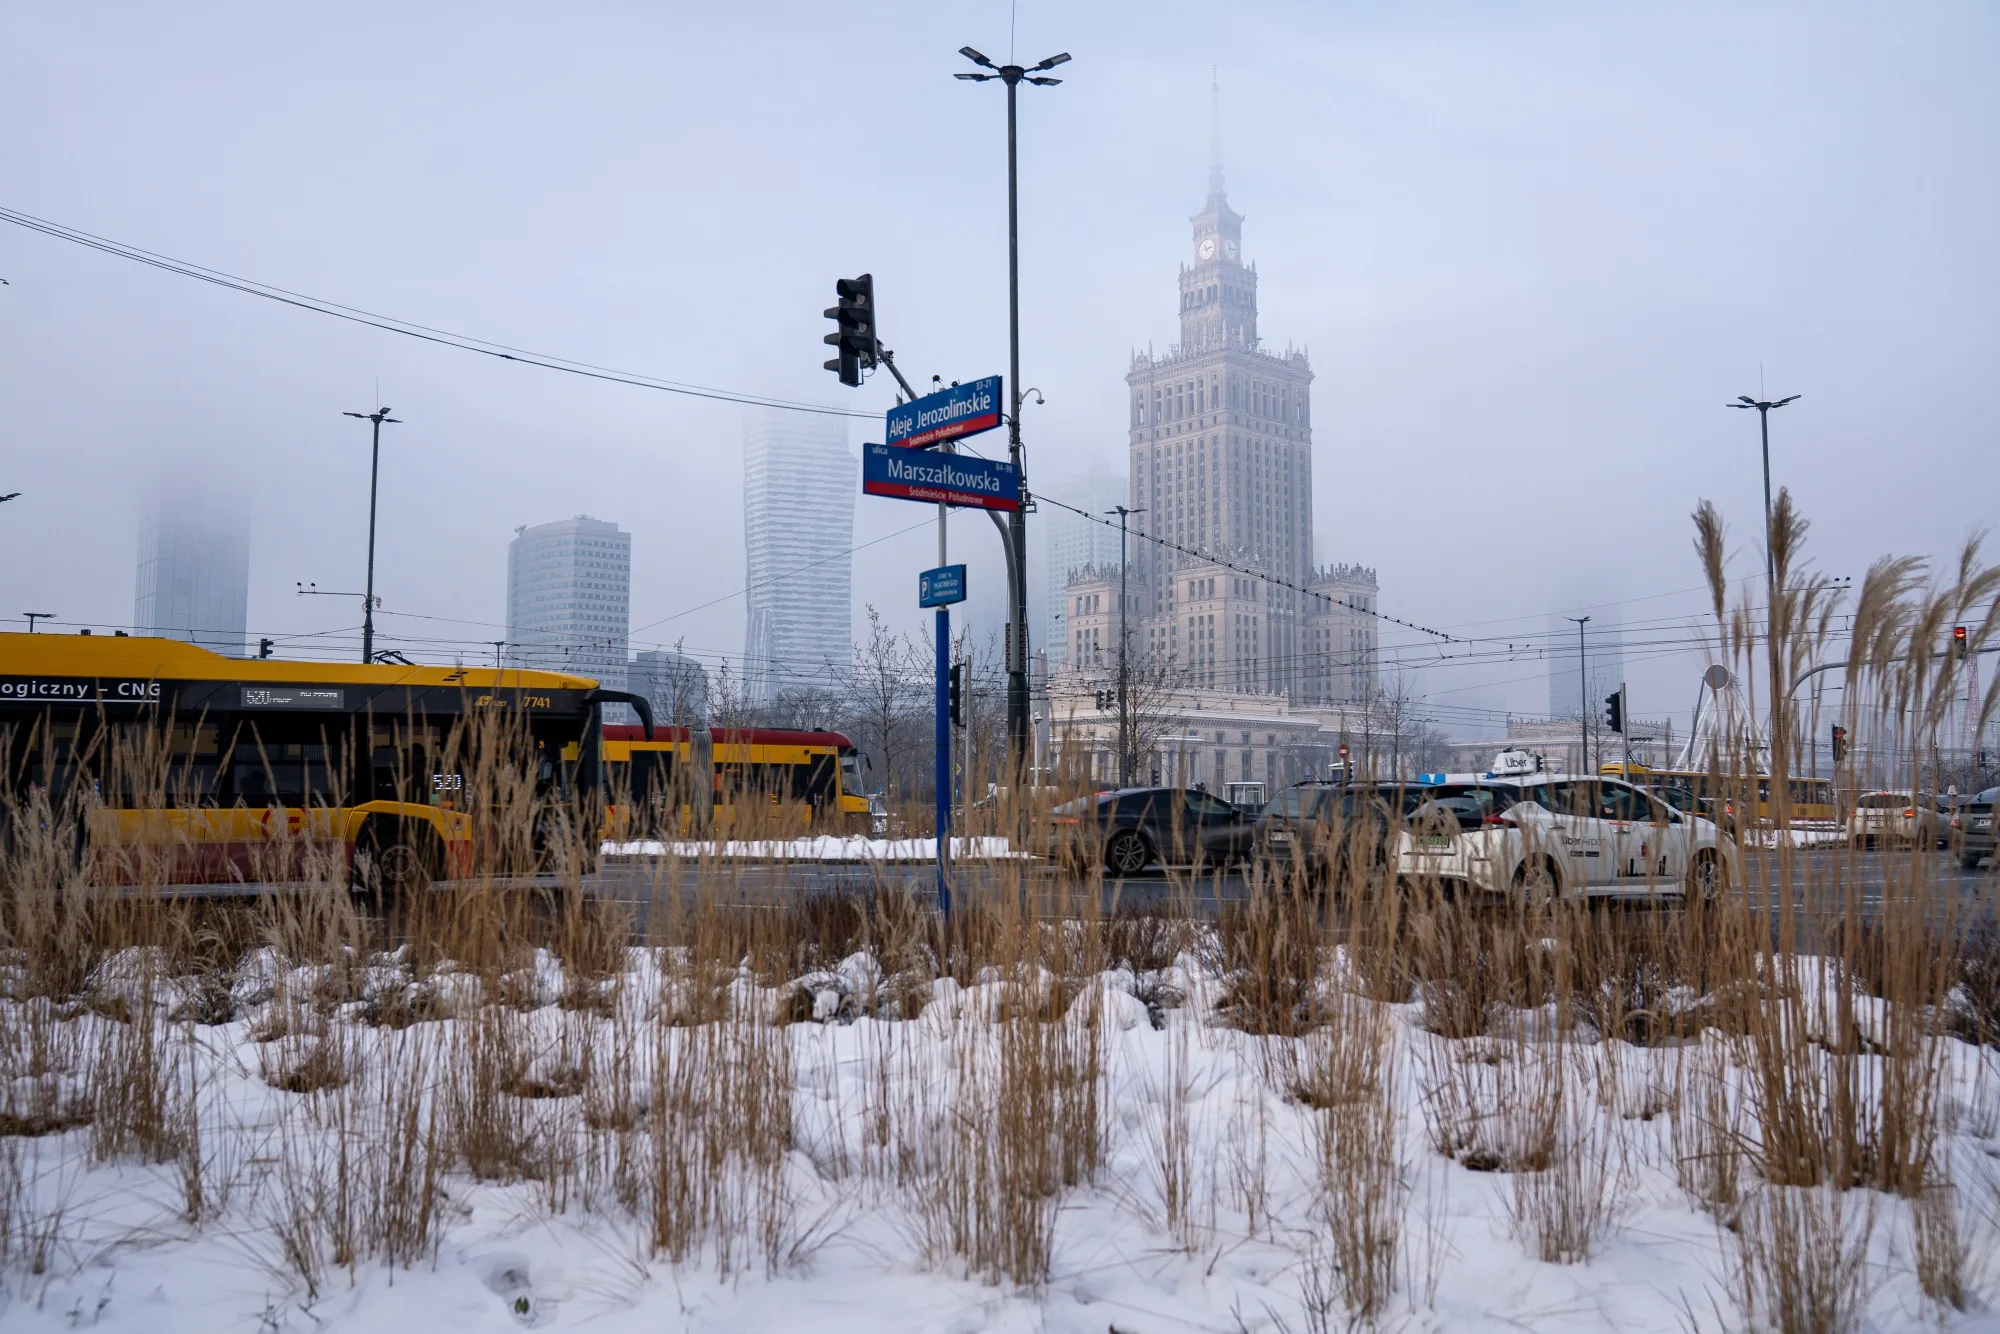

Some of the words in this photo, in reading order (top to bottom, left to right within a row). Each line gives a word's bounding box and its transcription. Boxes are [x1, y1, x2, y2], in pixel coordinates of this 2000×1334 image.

[888, 414, 913, 439] Aleje
[916, 391, 991, 430] Jerozolimskie
[872, 446, 888, 455] ulica
[887, 458, 1000, 492] Marszałkowska
[995, 463, 1013, 474] 84-98
[908, 486, 947, 500] Śródmieście
[948, 491, 984, 505] Południowe
[117, 682, 161, 697] CNG
[523, 696, 551, 708] 7741
[1504, 757, 1528, 768] Uber
[433, 774, 462, 790] 520
